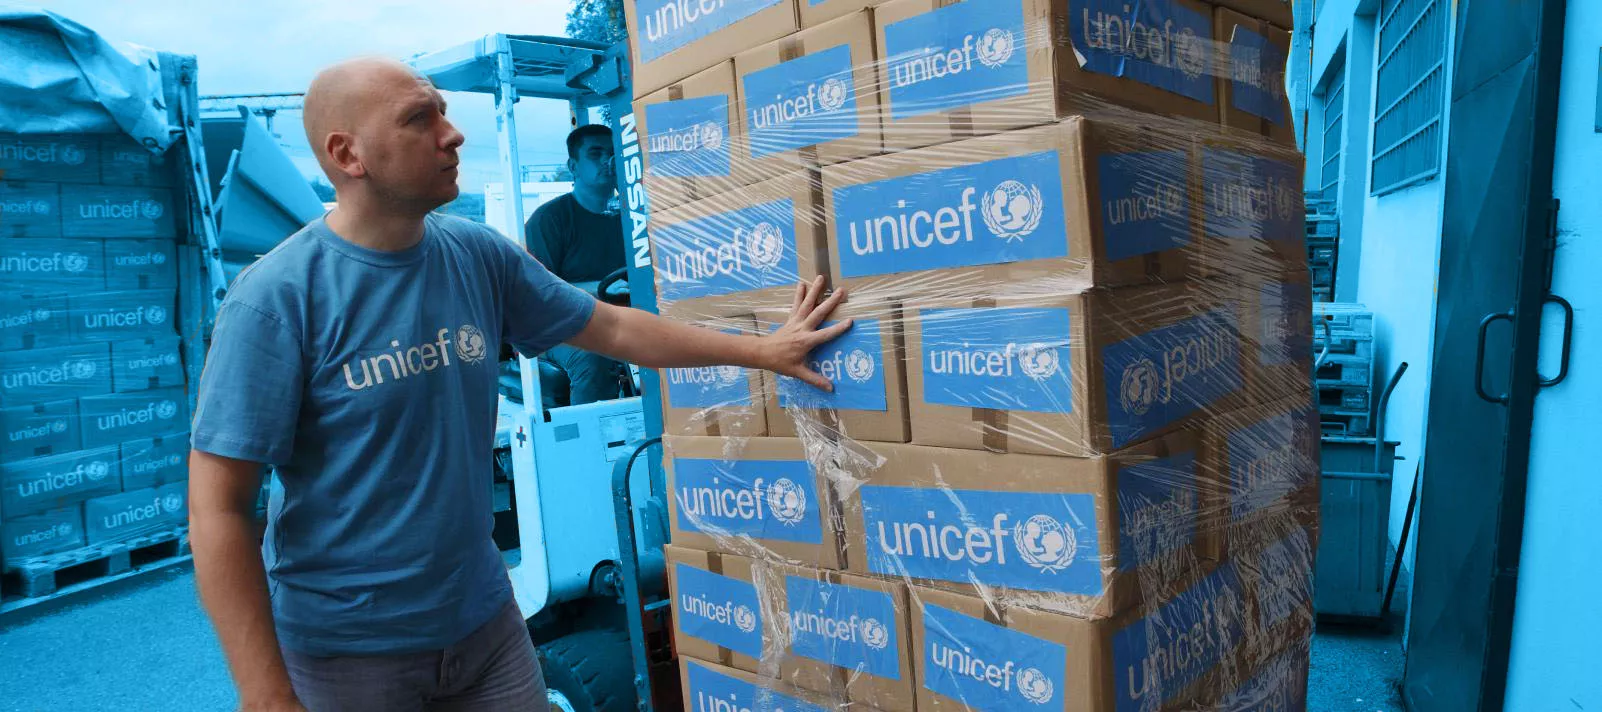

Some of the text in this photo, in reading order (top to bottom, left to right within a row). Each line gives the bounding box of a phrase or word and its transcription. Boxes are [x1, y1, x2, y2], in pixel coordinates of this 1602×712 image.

[645, 0, 724, 42] unice
[1082, 4, 1174, 67] unicef
[894, 34, 974, 88] unicef
[753, 83, 817, 129] unicef
[0, 141, 57, 162] nicef
[651, 122, 701, 153] unicef
[0, 199, 32, 214] nicef
[620, 112, 651, 269] NISSAN
[1107, 183, 1163, 226] unicef
[79, 199, 144, 219] unicef
[850, 186, 977, 256] unicef
[115, 252, 152, 267] unicef
[666, 226, 744, 283] unicef
[0, 311, 33, 329] nicef
[84, 305, 145, 329] unicef
[3, 360, 71, 389] unicef
[128, 354, 165, 371] unicef
[342, 327, 451, 391] unicef
[930, 342, 1016, 377] unicef
[8, 422, 52, 442] unicef
[97, 401, 156, 431] unicef
[18, 463, 86, 498] unicef
[134, 456, 169, 474] unicef
[104, 497, 161, 530] unicef
[682, 476, 765, 520] unicef
[15, 525, 57, 547] unicef
[878, 510, 1009, 565] unicef
[682, 593, 733, 627] unicef
[794, 608, 858, 644] unicef
[931, 641, 1015, 692] unicef
[698, 691, 784, 712] uni
